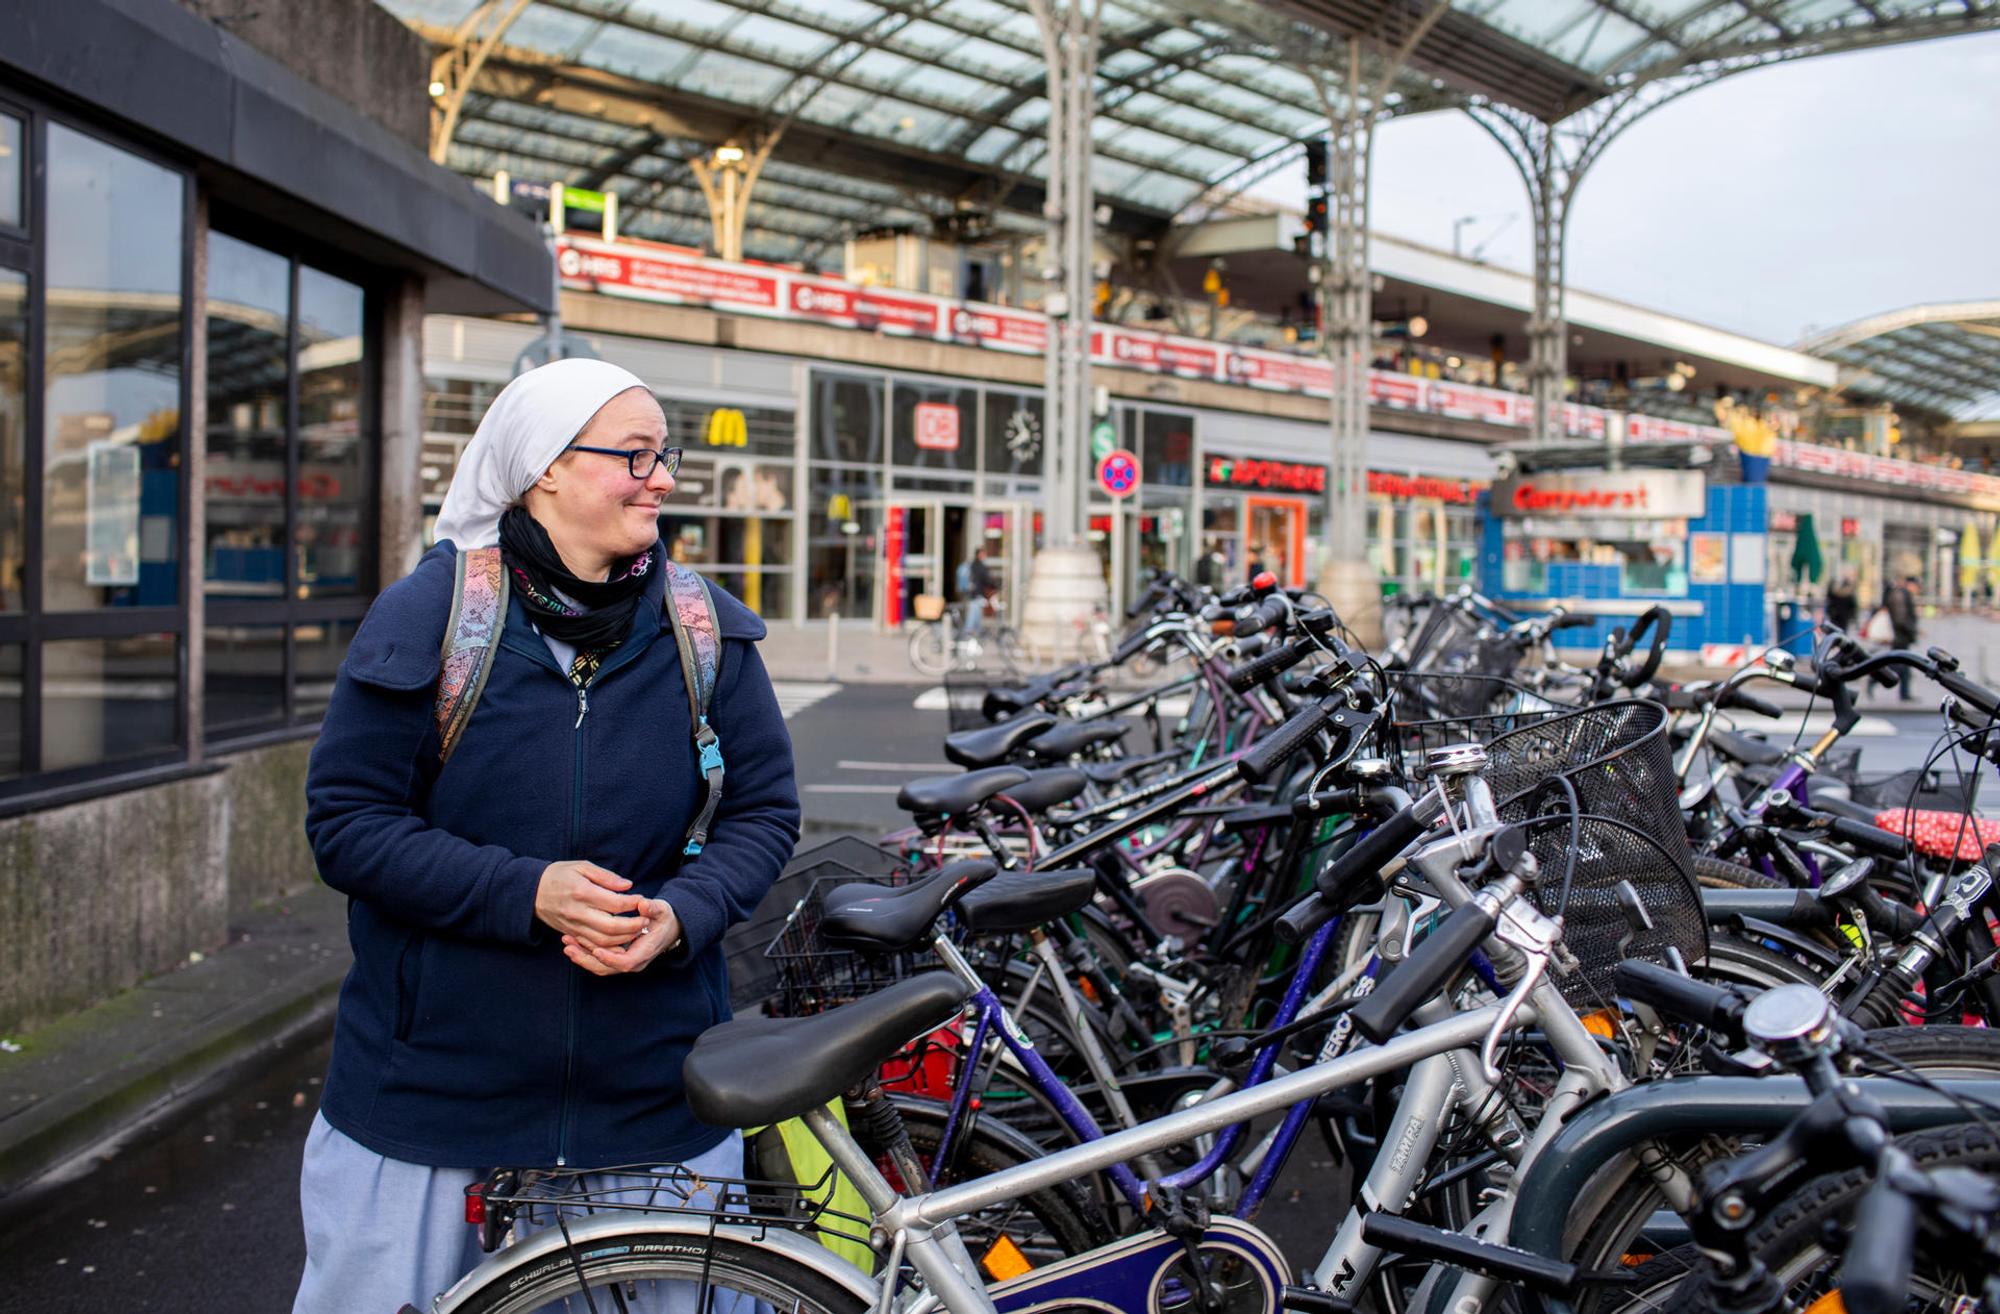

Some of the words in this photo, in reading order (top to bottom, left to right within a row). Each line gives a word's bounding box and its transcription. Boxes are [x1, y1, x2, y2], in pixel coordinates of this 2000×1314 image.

[1231, 458, 1325, 492] APOTHEKE
[1316, 976, 1376, 1064] HERCES
[1390, 1115, 1424, 1175] TAMPA
